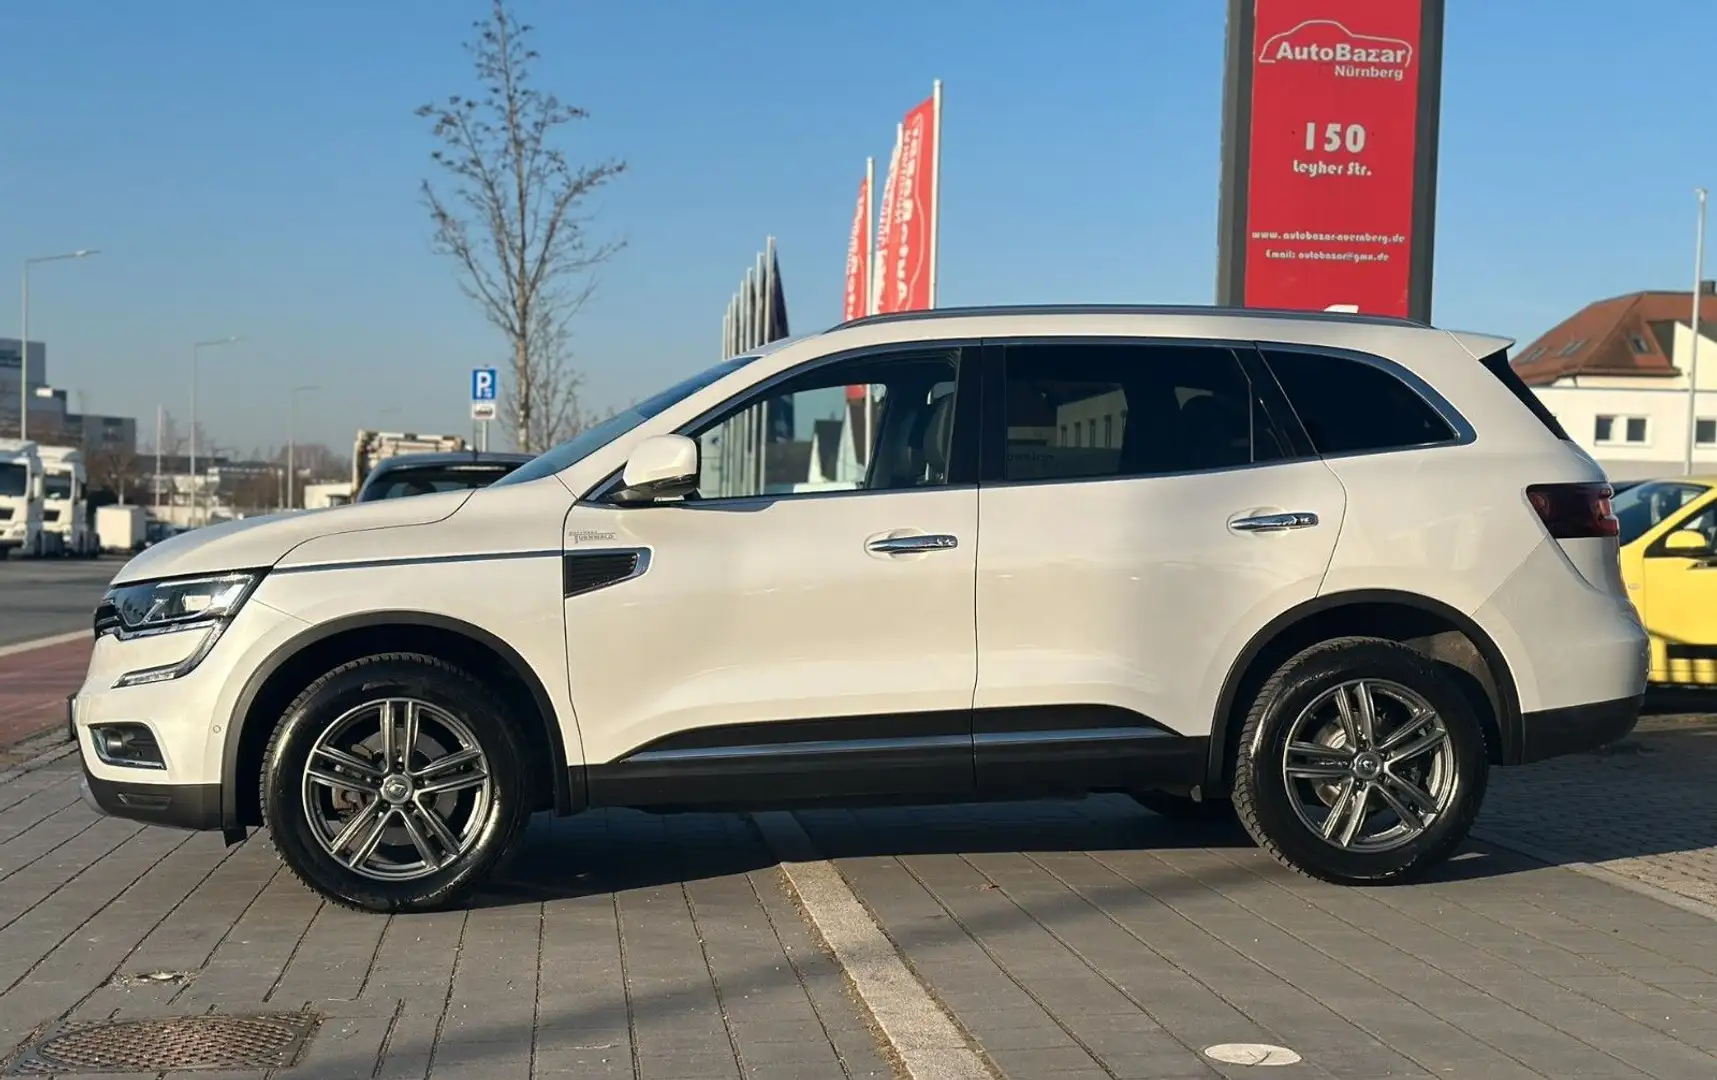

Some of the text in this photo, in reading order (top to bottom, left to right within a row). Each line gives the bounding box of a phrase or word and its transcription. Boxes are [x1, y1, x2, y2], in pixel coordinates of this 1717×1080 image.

[1276, 41, 1406, 63] AutoBazar
[1334, 65, 1404, 81] Nürnberg
[1305, 122, 1366, 153] 150
[1347, 162, 1373, 176] Str.
[476, 371, 492, 398] P
